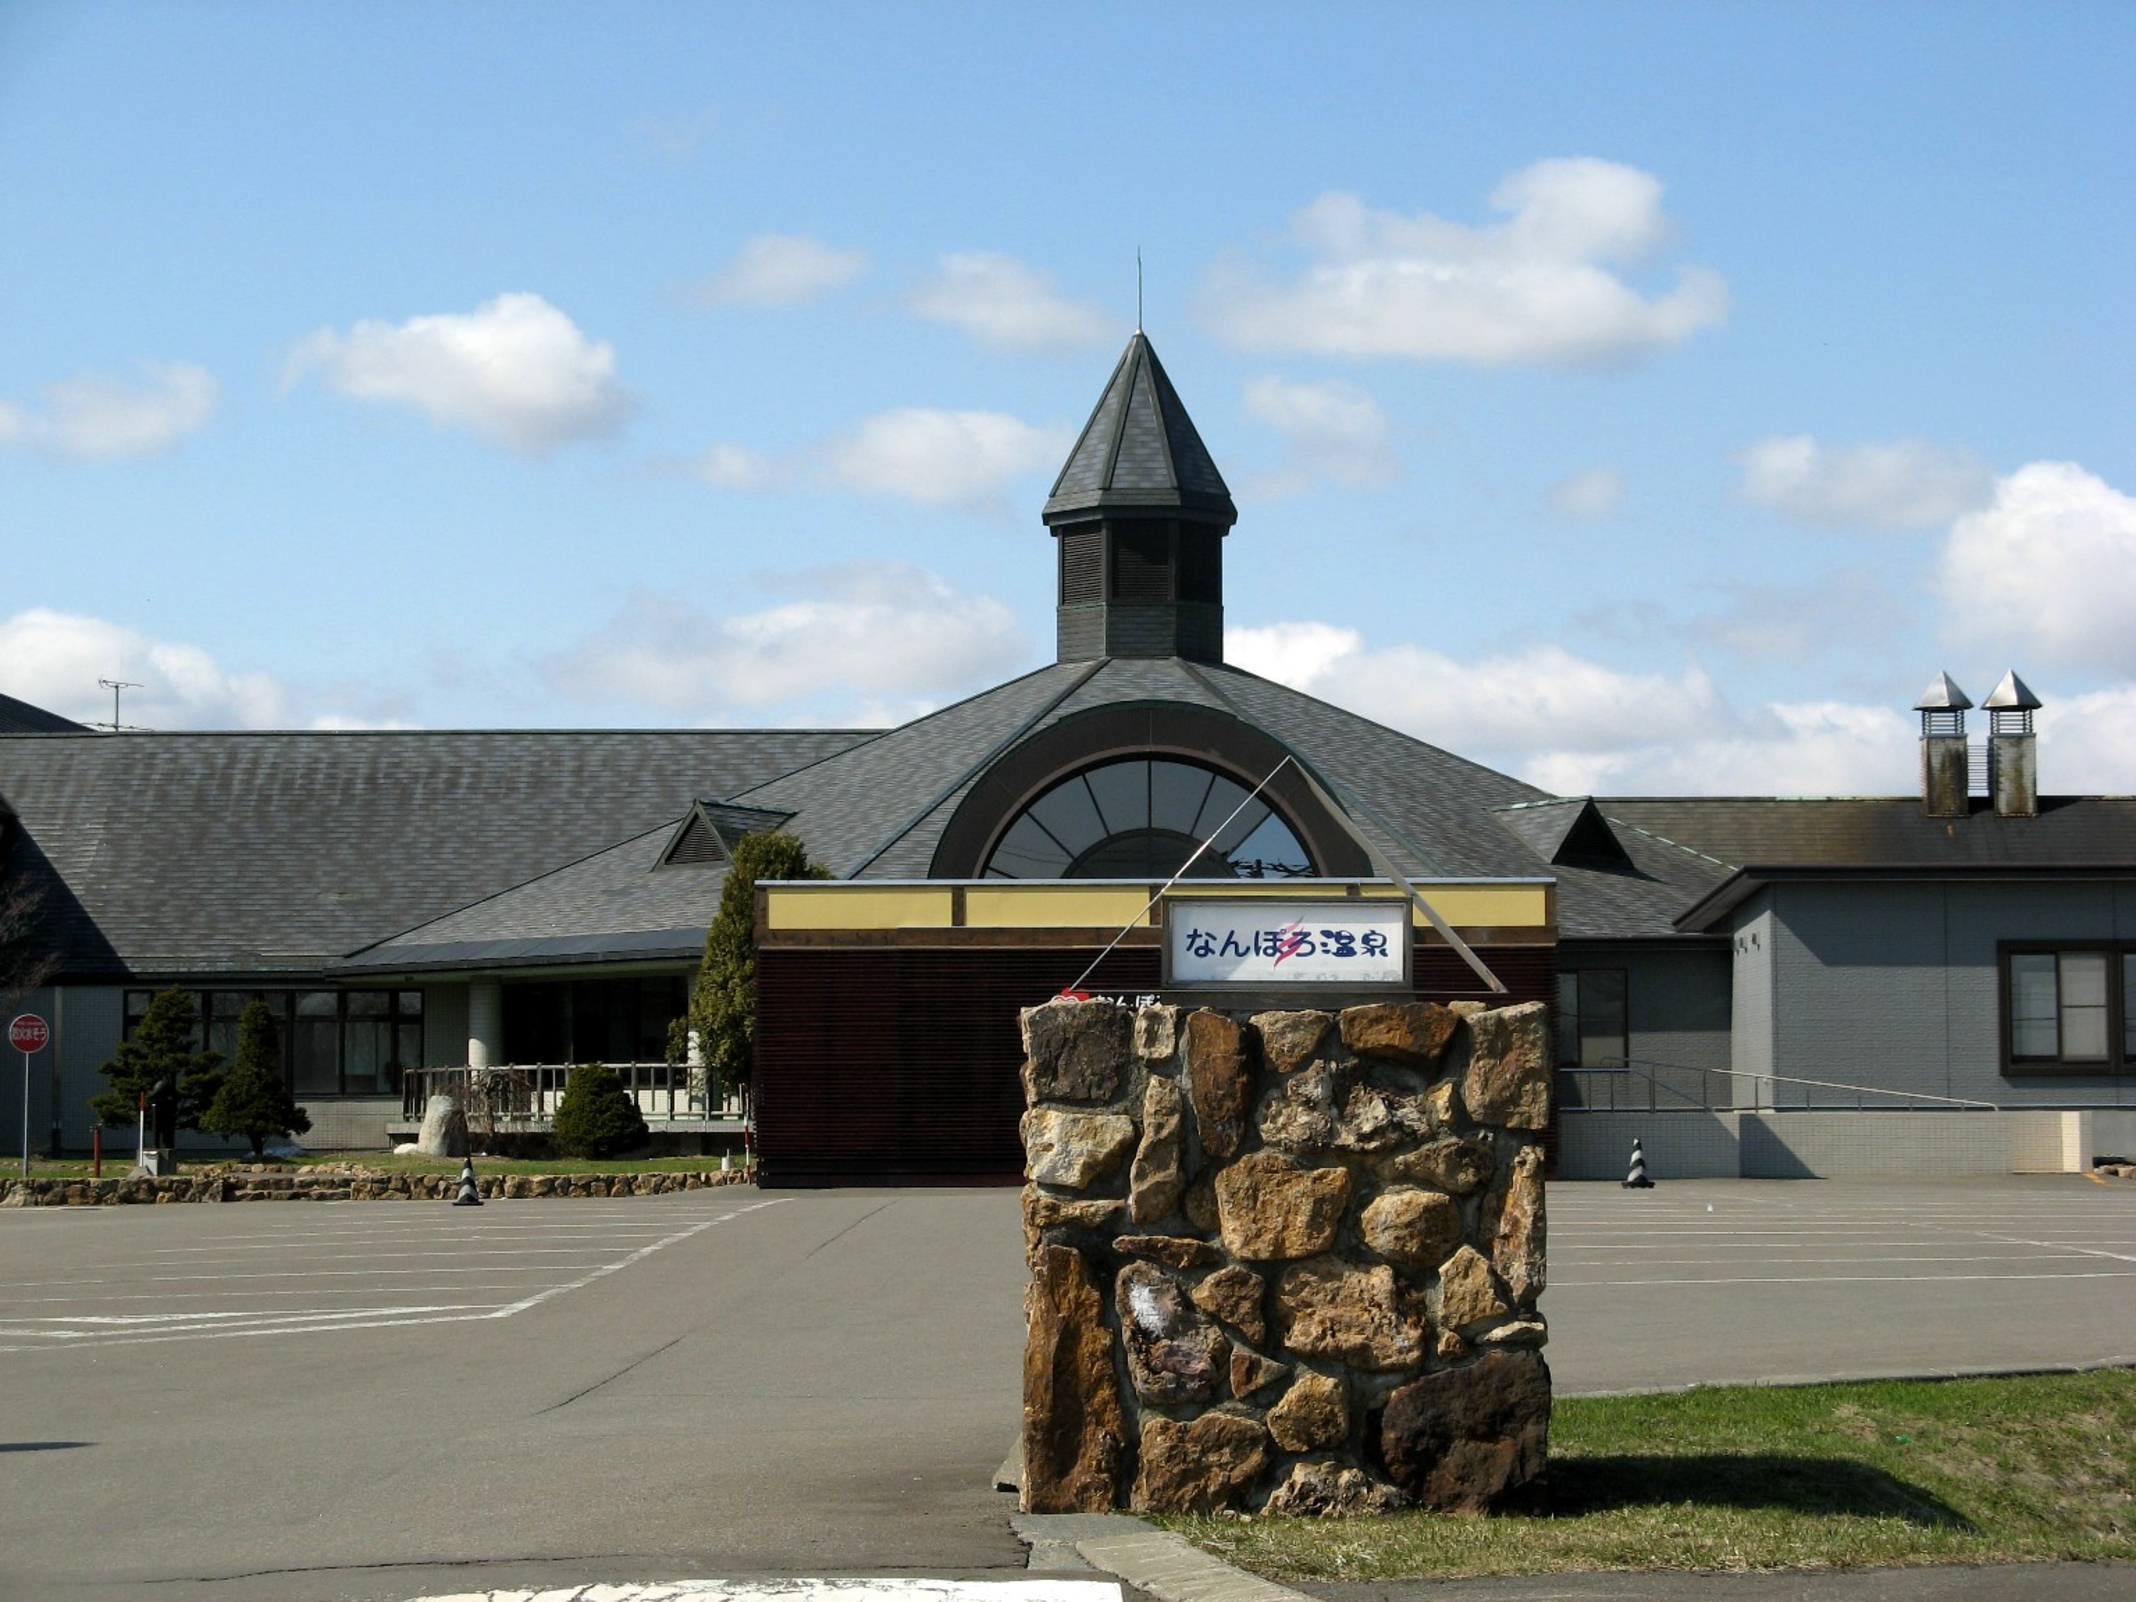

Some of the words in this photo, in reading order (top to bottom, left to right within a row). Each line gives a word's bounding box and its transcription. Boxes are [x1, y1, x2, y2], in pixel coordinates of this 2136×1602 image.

[1186, 928, 1389, 957] なんぽろ温泉
